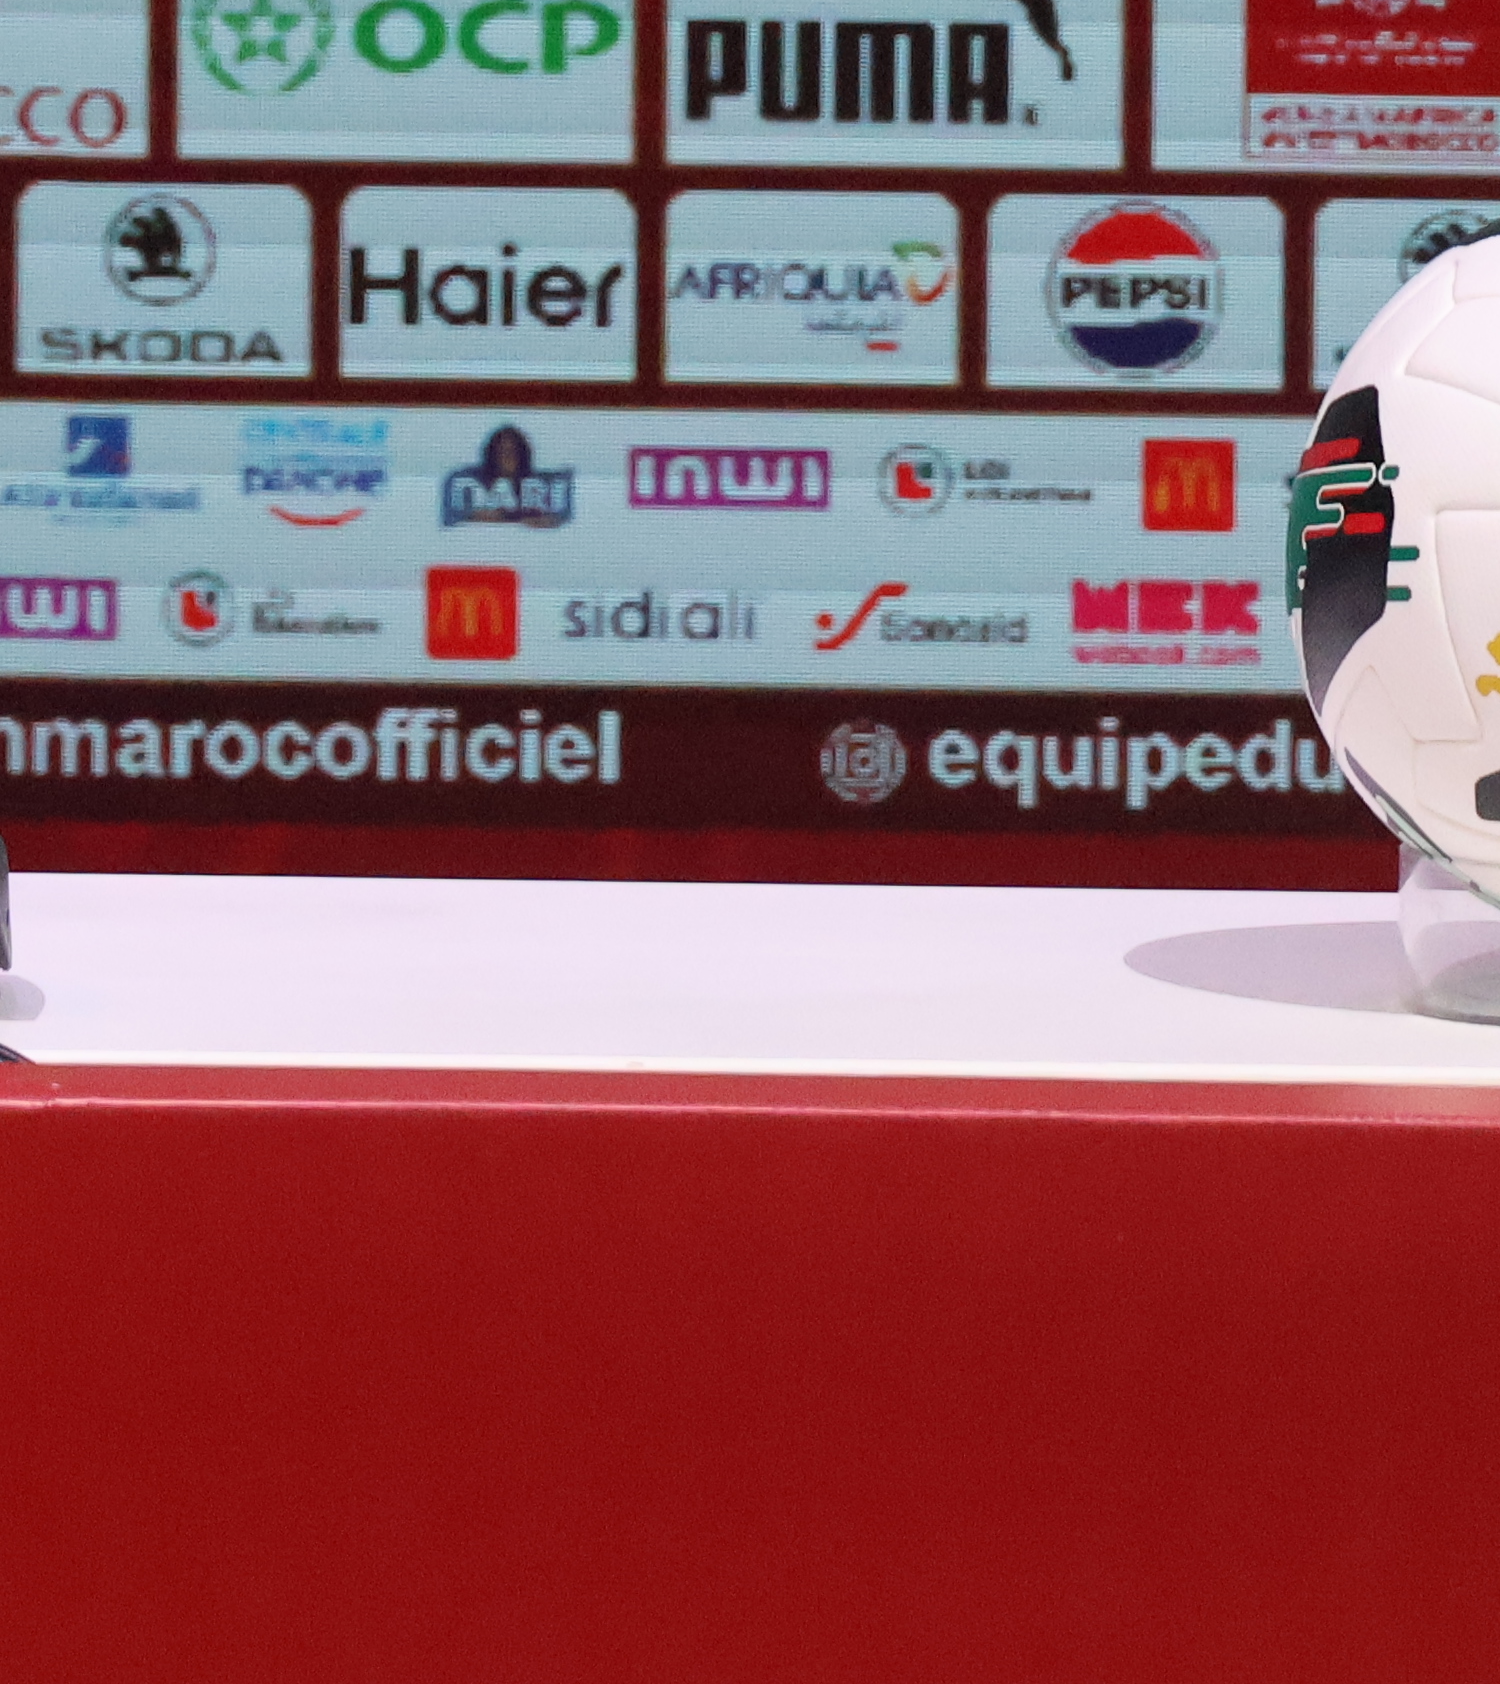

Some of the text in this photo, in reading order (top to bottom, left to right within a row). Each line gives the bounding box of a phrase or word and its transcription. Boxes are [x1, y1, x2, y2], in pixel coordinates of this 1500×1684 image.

[686, 20, 1009, 124] PUMA
[341, 244, 622, 327] Haier
[670, 263, 899, 302] AFRIQUIA
[1061, 276, 1207, 310] PEPSI
[447, 479, 571, 519] DARI
[630, 456, 824, 502] inwi
